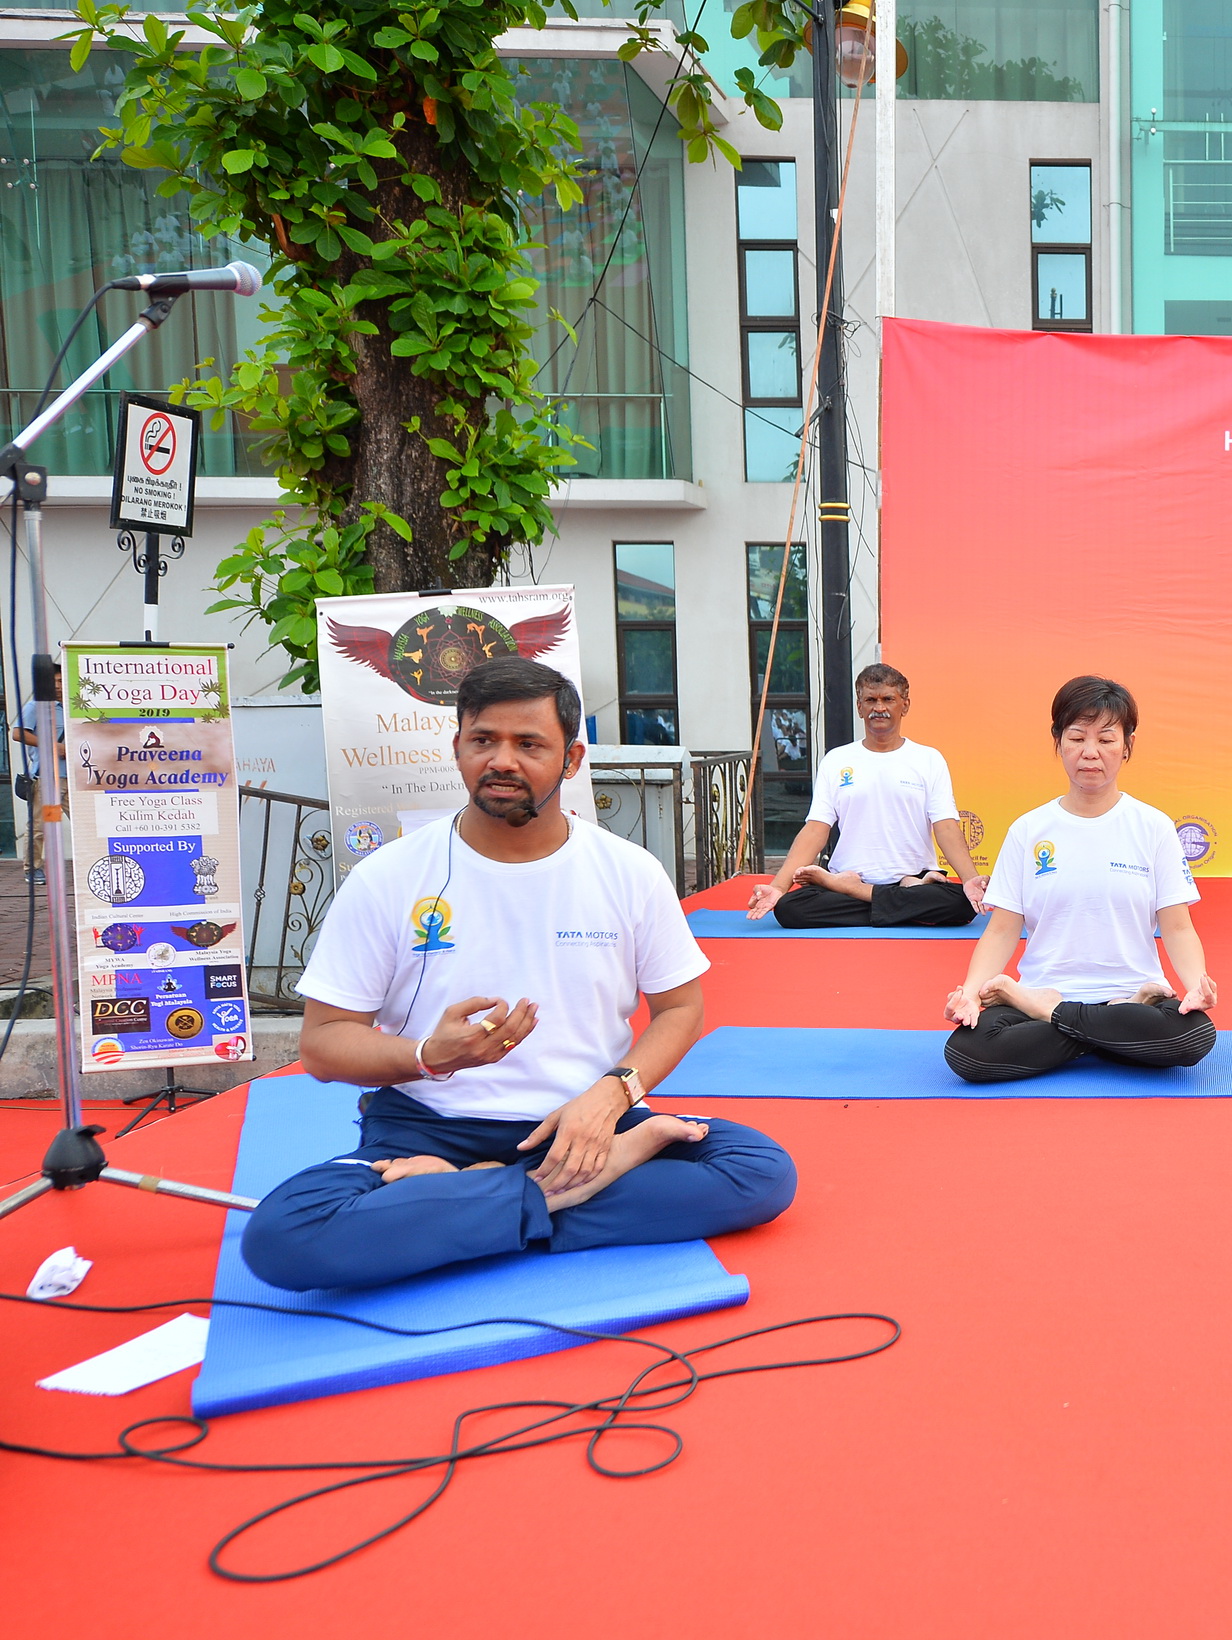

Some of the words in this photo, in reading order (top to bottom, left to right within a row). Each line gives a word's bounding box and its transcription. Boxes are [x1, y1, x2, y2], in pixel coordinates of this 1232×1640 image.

[144, 488, 172, 499] SMOKING
[121, 495, 152, 506] DILARANG
[154, 500, 183, 511] MEROKOK
[141, 508, 166, 520] 禁止吸烟
[392, 634, 410, 660] MALAYSIA
[414, 613, 430, 626] YOGA
[457, 606, 484, 622] WELLNESS
[487, 619, 518, 651] ASSOCIATION
[84, 658, 213, 675] International
[100, 684, 152, 705] Yoga
[160, 684, 200, 705] Day
[139, 709, 170, 717] 2019
[116, 746, 202, 762] Praveena
[340, 745, 442, 768] Wellness
[93, 770, 138, 789] Yoga
[145, 769, 228, 786] Academy
[392, 784, 402, 794] In
[406, 782, 426, 793] The
[110, 796, 135, 806] Free
[138, 796, 166, 808] Yoga
[171, 795, 203, 805] Class
[119, 811, 154, 821] Kulim
[158, 810, 195, 820] Kedah
[336, 803, 393, 818] Registered
[115, 824, 132, 832] Call
[1182, 815, 1217, 836] ORGANISATION
[113, 841, 174, 854] Supported
[178, 840, 196, 853] By
[1128, 864, 1149, 872] MOTORS
[585, 932, 618, 940] MOTORS
[92, 974, 142, 986] MPNA
[210, 981, 237, 989] FOCUS
[93, 1000, 147, 1016] DCC
